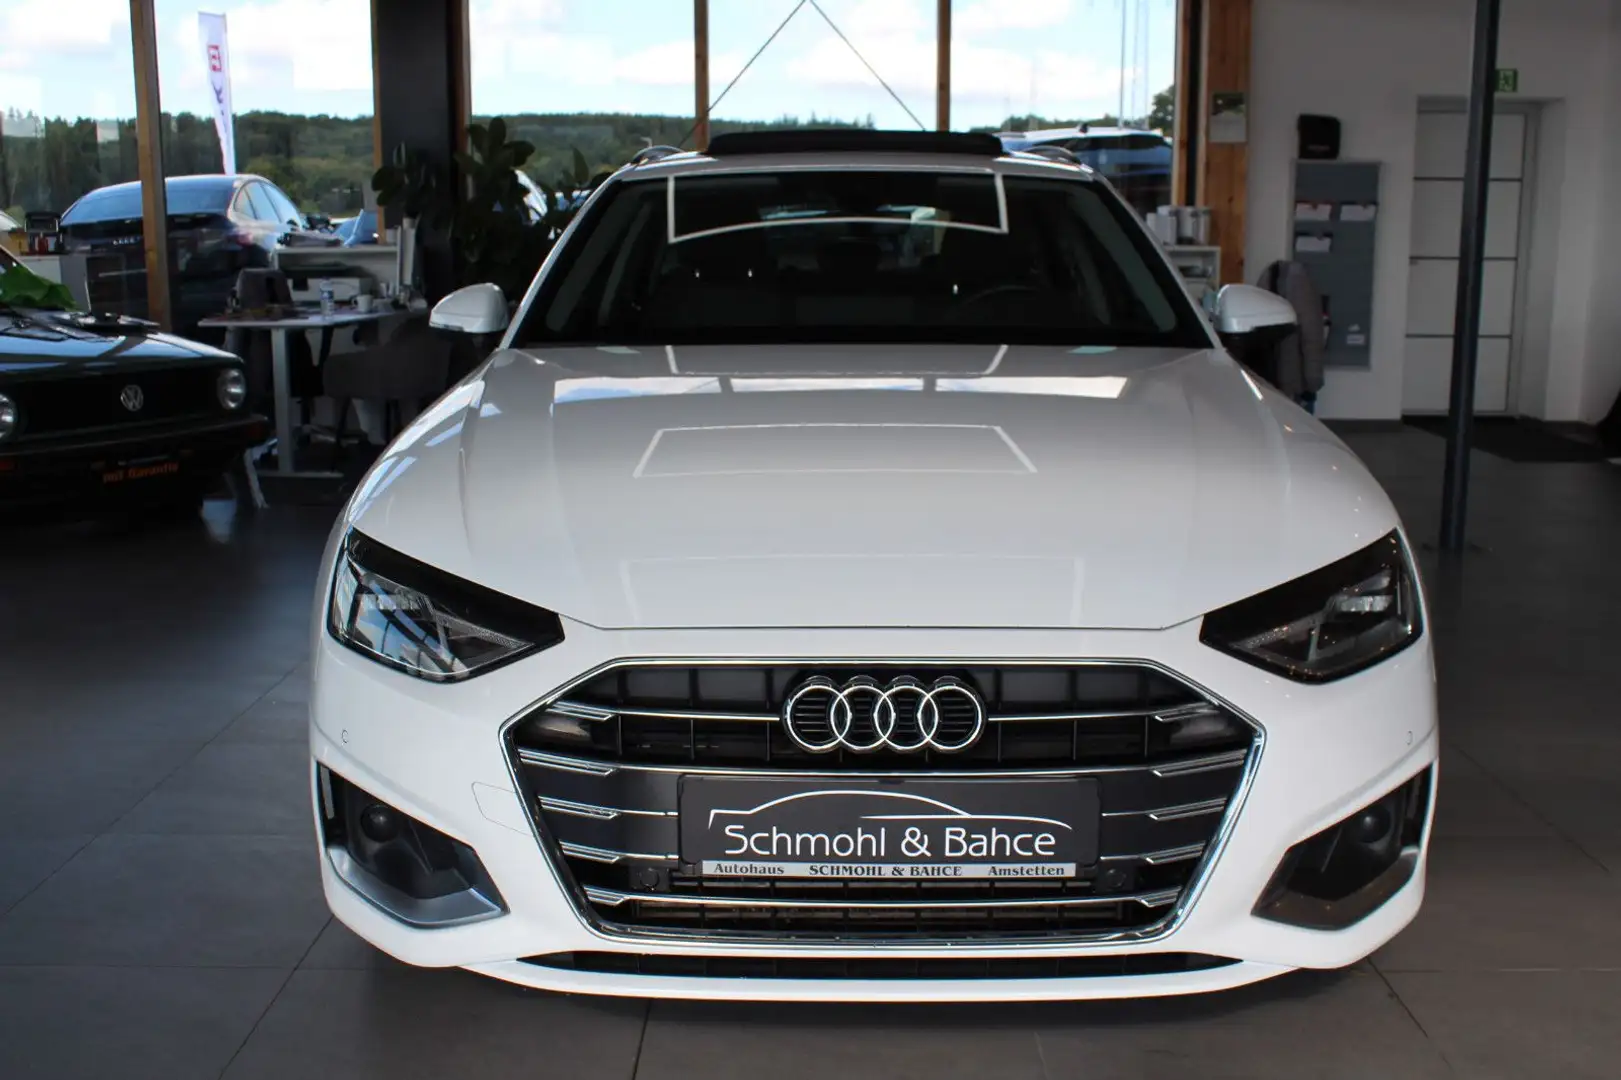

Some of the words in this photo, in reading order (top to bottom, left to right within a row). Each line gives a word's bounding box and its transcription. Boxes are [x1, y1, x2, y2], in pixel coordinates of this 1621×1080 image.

[724, 824, 886, 857] Schmohl
[900, 826, 932, 858] &
[944, 826, 1056, 857] Bahce
[713, 862, 785, 875] Autohaus
[808, 864, 886, 877] SCHMOHL
[891, 865, 905, 877] &
[909, 865, 963, 877] BAHCE
[987, 865, 1066, 877] Amstetten
